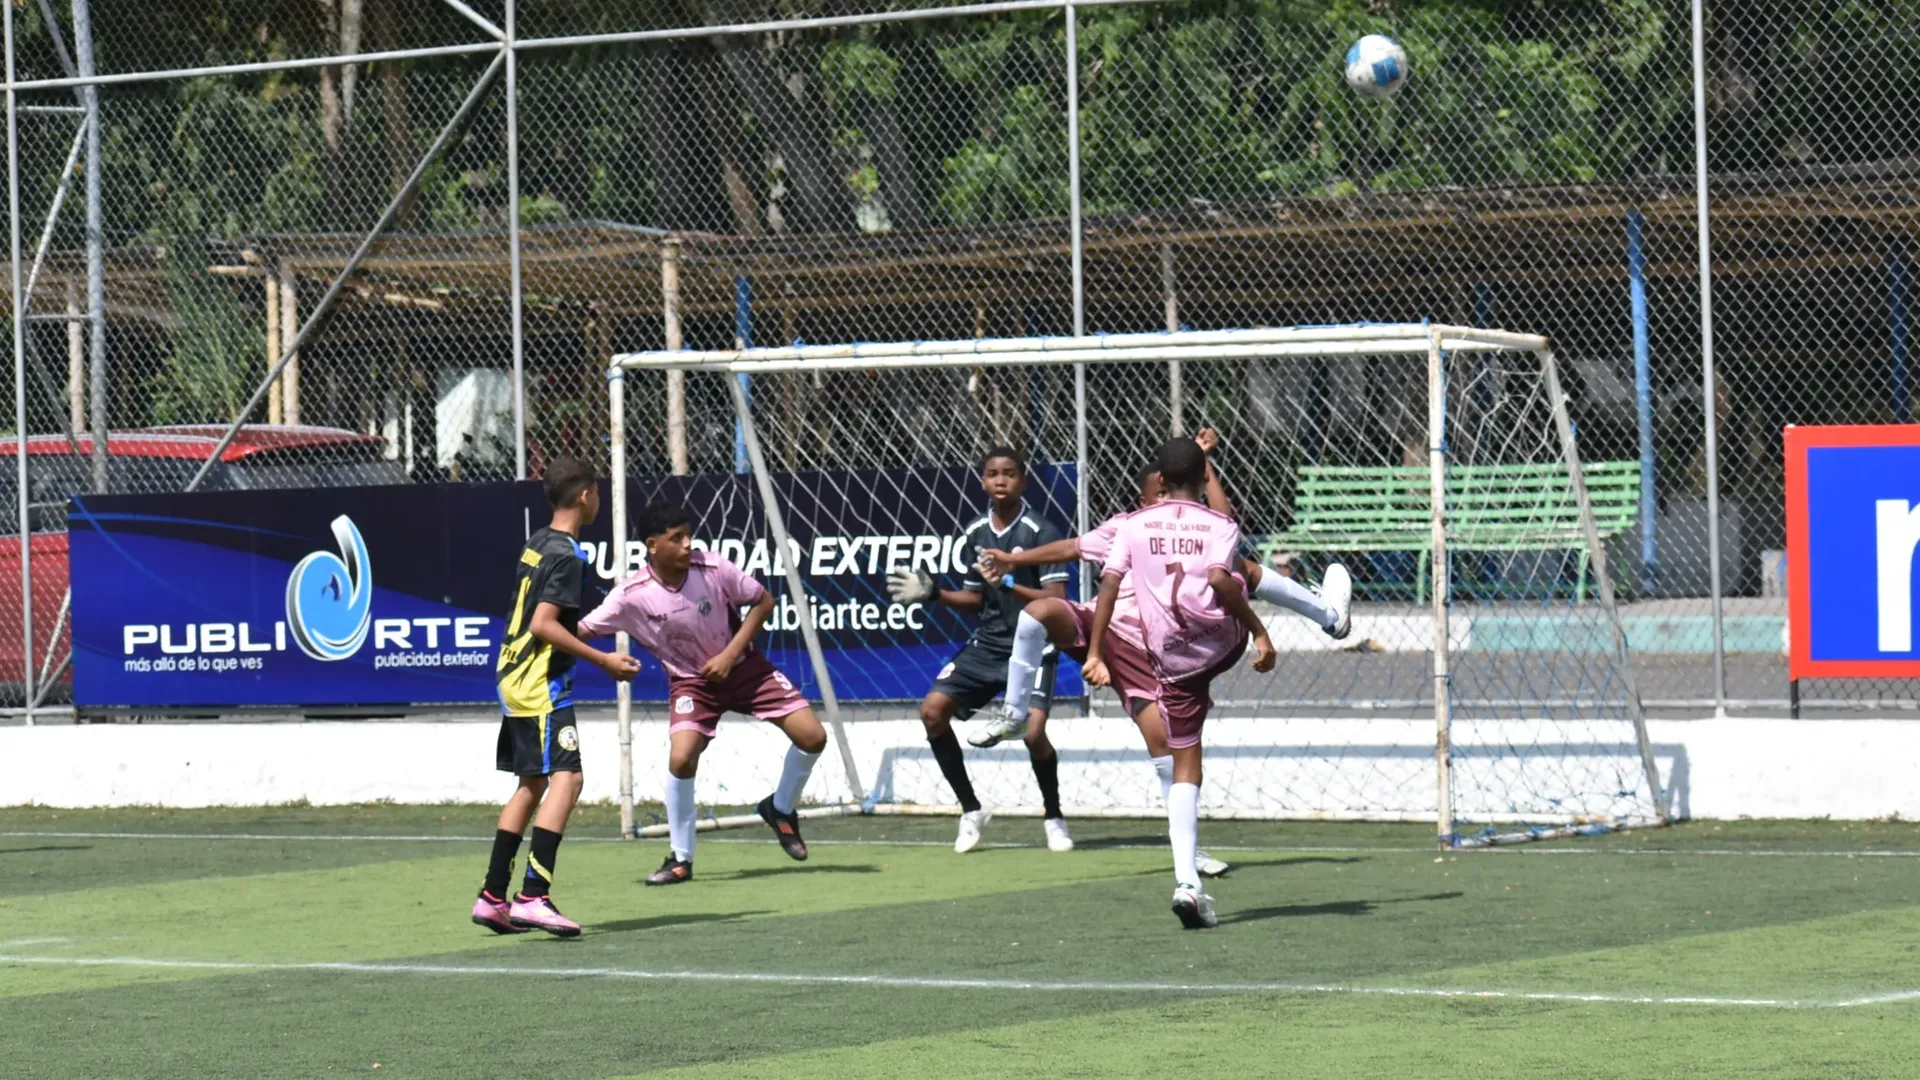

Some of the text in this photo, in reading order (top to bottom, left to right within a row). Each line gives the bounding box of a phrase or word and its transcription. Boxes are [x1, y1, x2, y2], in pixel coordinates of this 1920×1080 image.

[1149, 537, 1204, 555] DE LEON
[1165, 561, 1187, 629] 7
[124, 656, 263, 673] más allá de lo que ves
[374, 650, 490, 670] publicidad exterior
